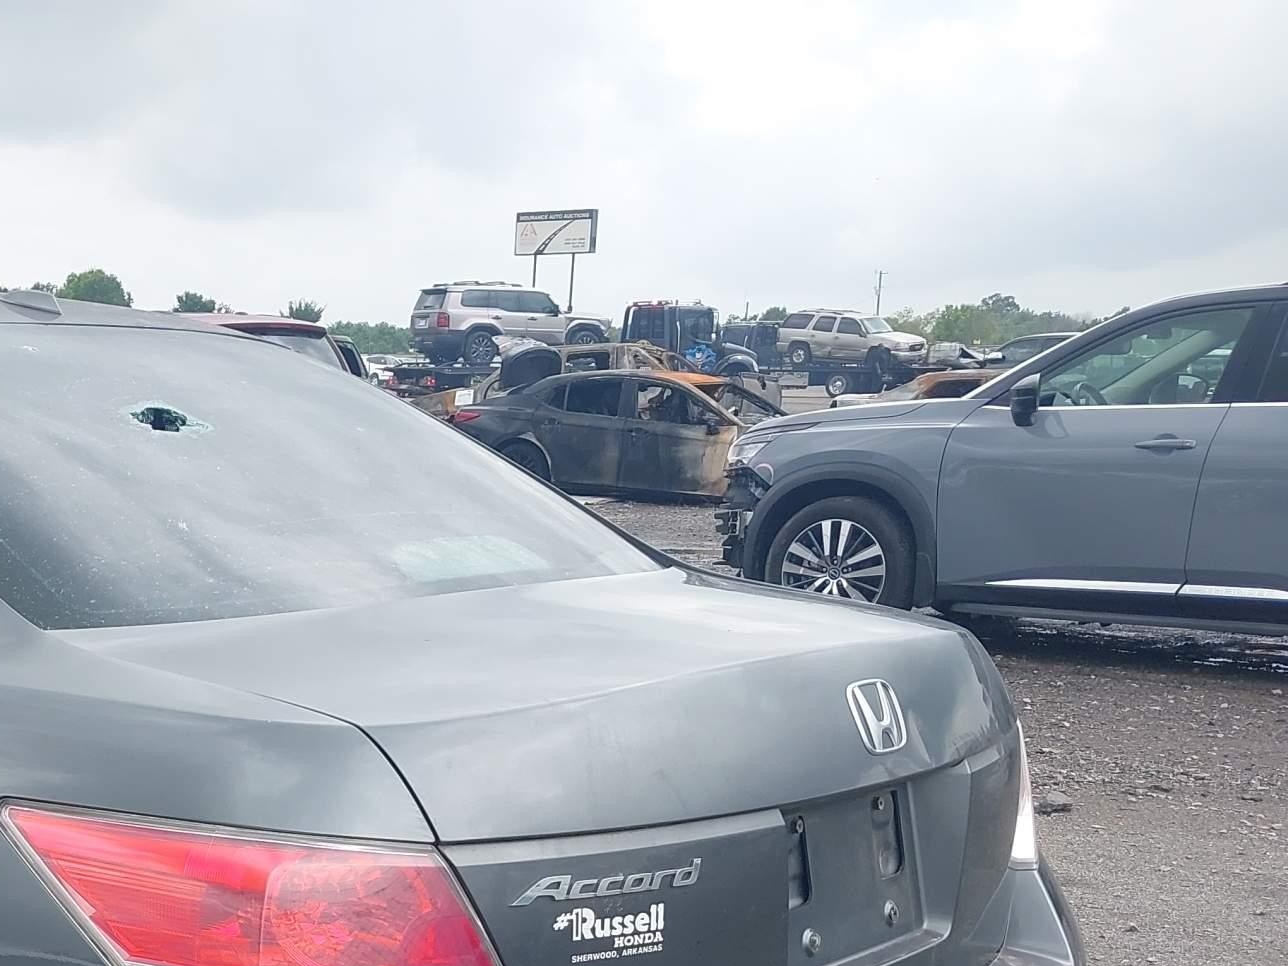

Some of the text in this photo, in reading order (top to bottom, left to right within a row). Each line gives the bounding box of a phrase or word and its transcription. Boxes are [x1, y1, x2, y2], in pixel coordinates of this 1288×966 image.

[508, 857, 702, 907] Accord
[614, 931, 664, 948] HONDA
[571, 943, 664, 964] SHERWOOD, ARKANSAS
